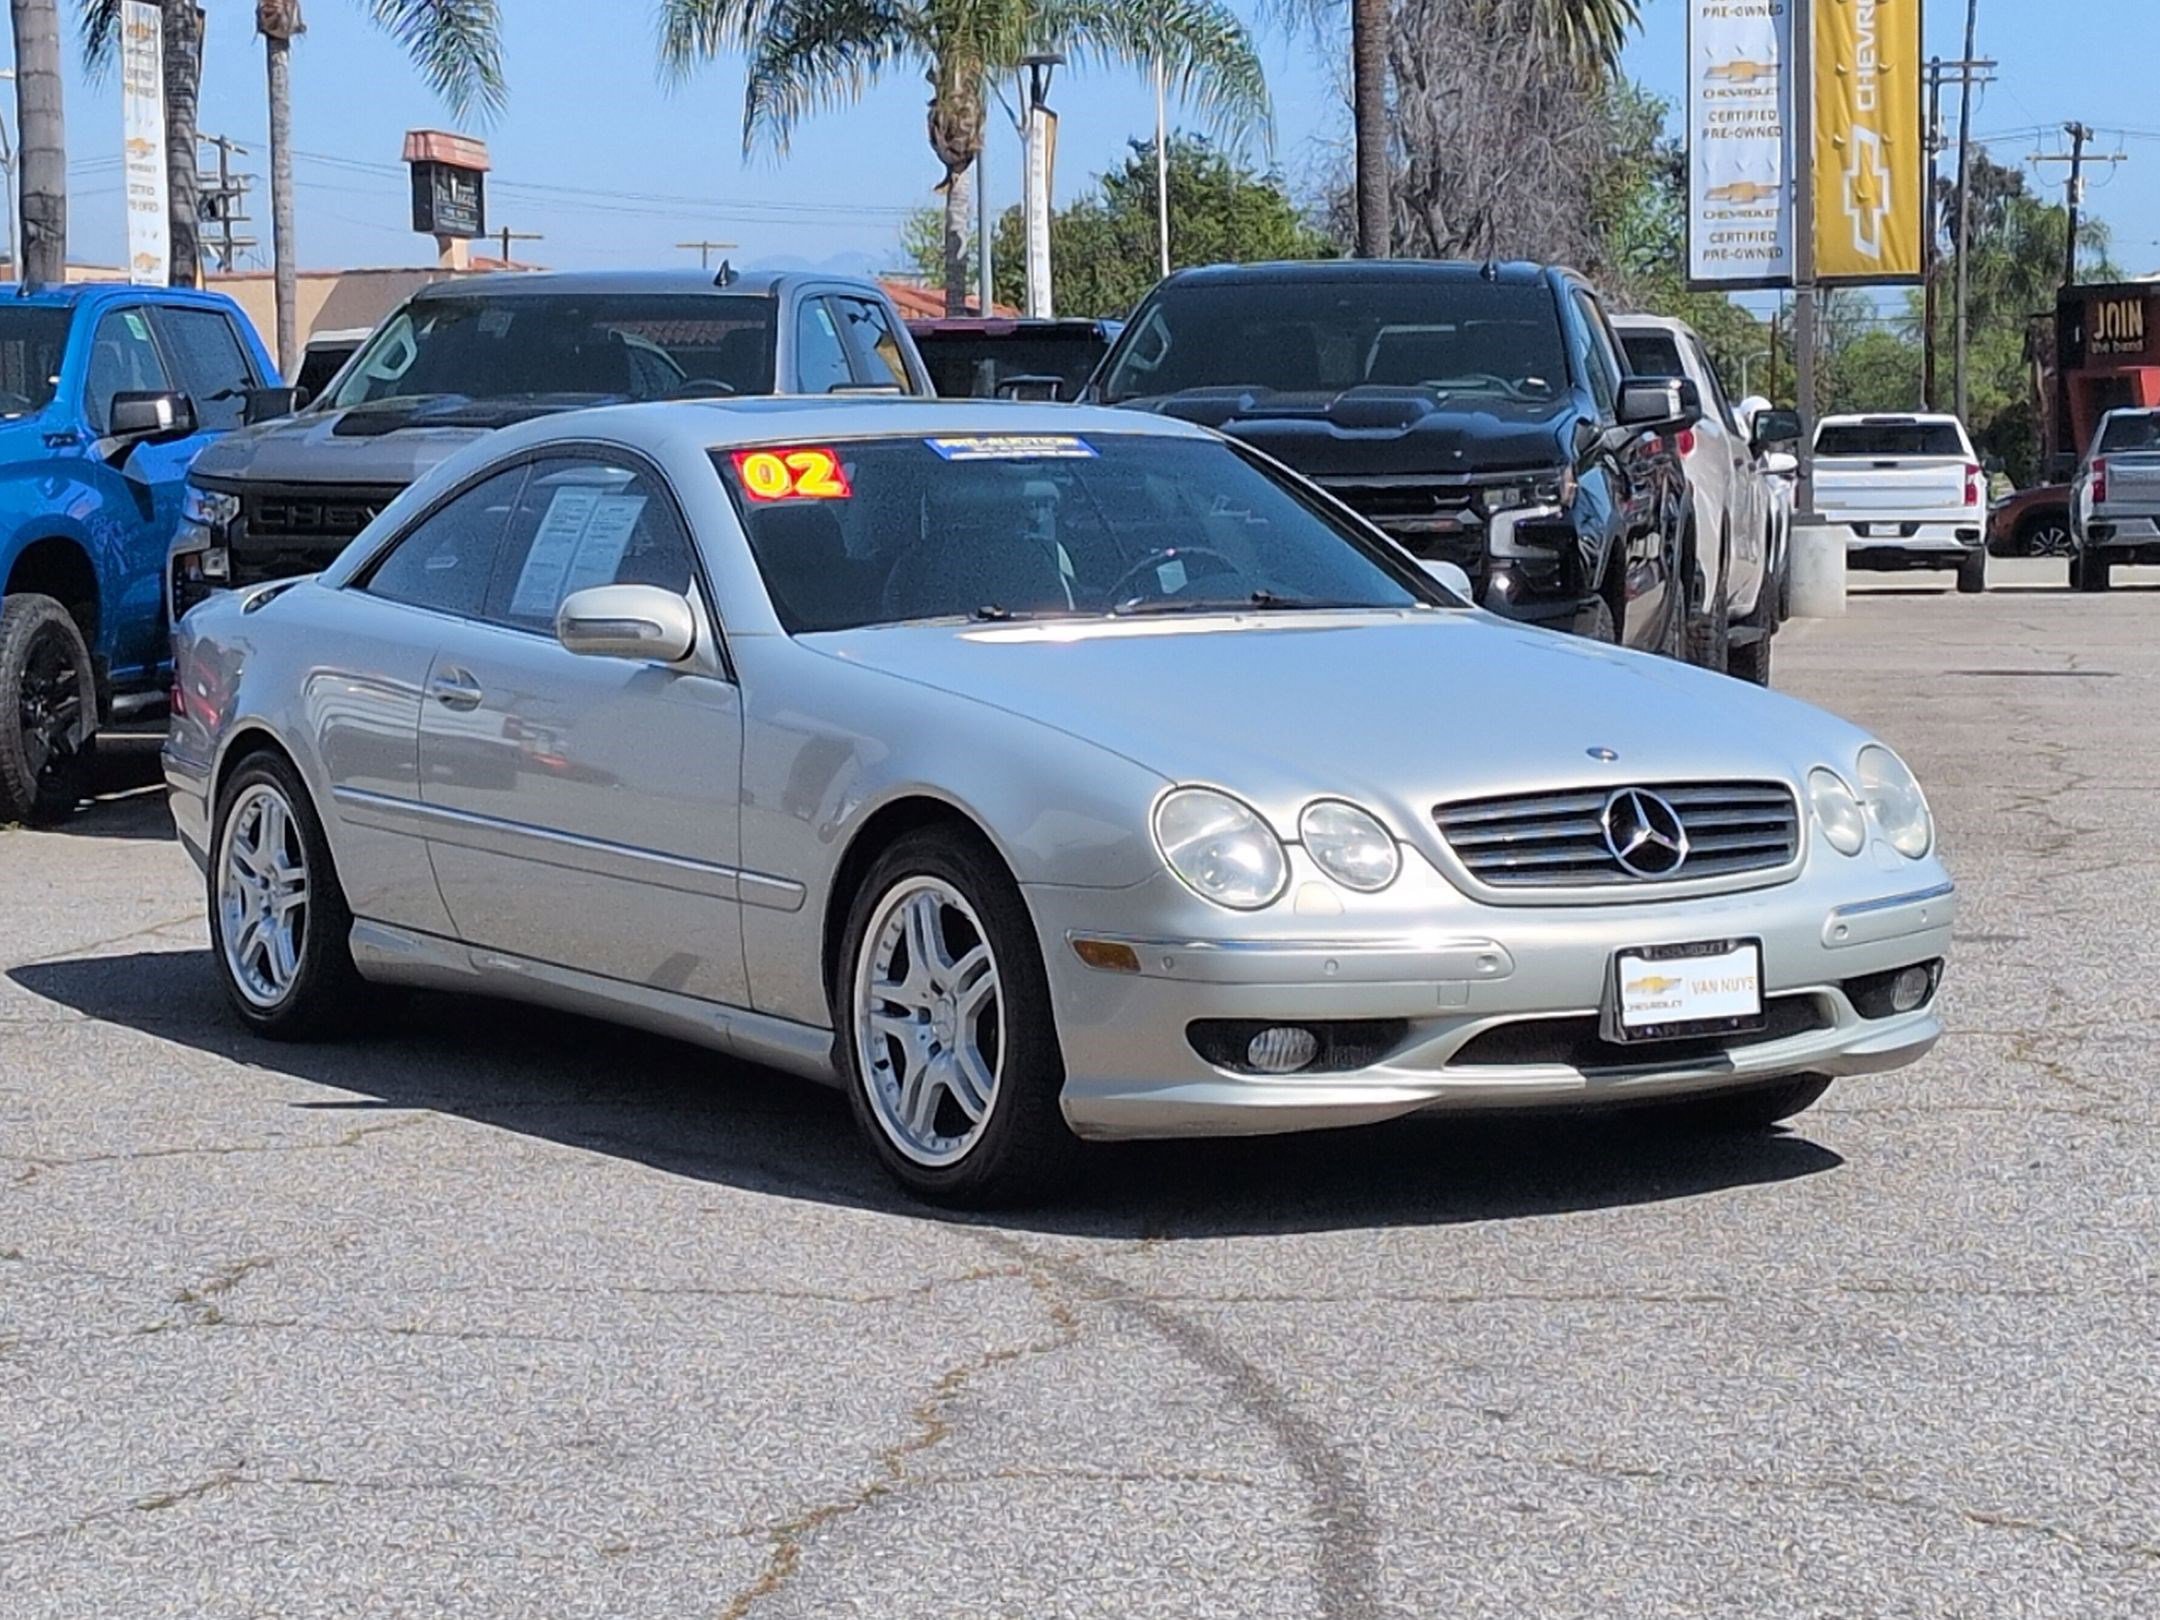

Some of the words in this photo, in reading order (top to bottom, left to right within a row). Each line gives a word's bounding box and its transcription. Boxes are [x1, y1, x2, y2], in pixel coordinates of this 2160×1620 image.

[1856, 0, 1876, 111] CHEVR
[1708, 110, 1777, 122] CERTIFIED
[1702, 126, 1783, 139] PRE-OWNED
[1703, 209, 1782, 220] CHEVROLET
[1709, 231, 1777, 243] CERTIFIED
[1703, 246, 1783, 260] PRE-OWNED
[2093, 300, 2143, 340] JOIN
[743, 452, 844, 498] 02
[1690, 979, 1718, 995] VAN
[1720, 976, 1756, 993] NUYS
